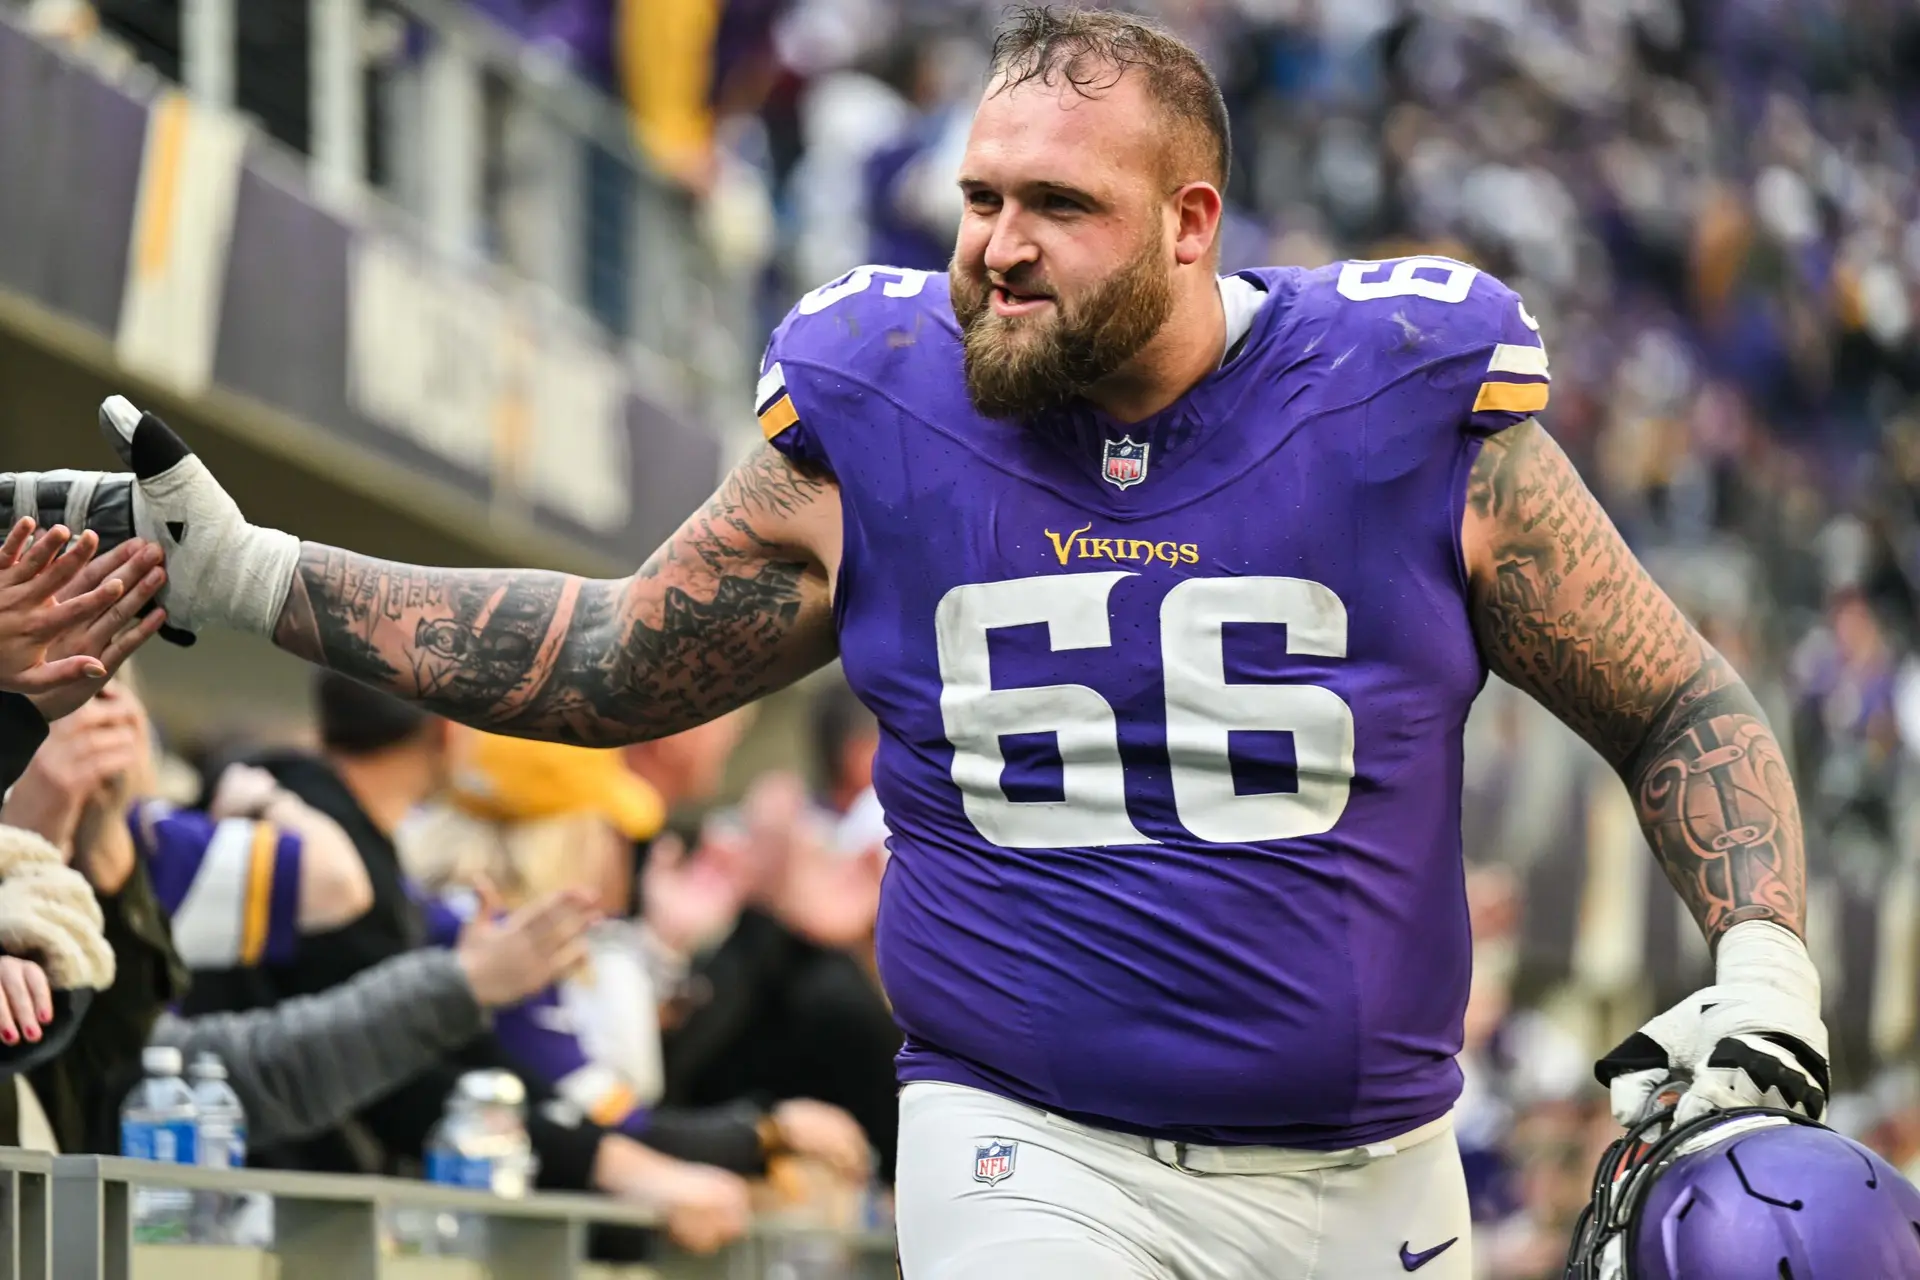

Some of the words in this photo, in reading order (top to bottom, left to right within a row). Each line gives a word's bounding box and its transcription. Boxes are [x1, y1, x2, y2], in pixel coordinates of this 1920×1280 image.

[1336, 254, 1482, 304] 6
[1108, 457, 1139, 480] NFL
[1045, 522, 1200, 568] VIKINGS
[935, 571, 1355, 848] 66
[979, 1156, 1008, 1177] NFL
